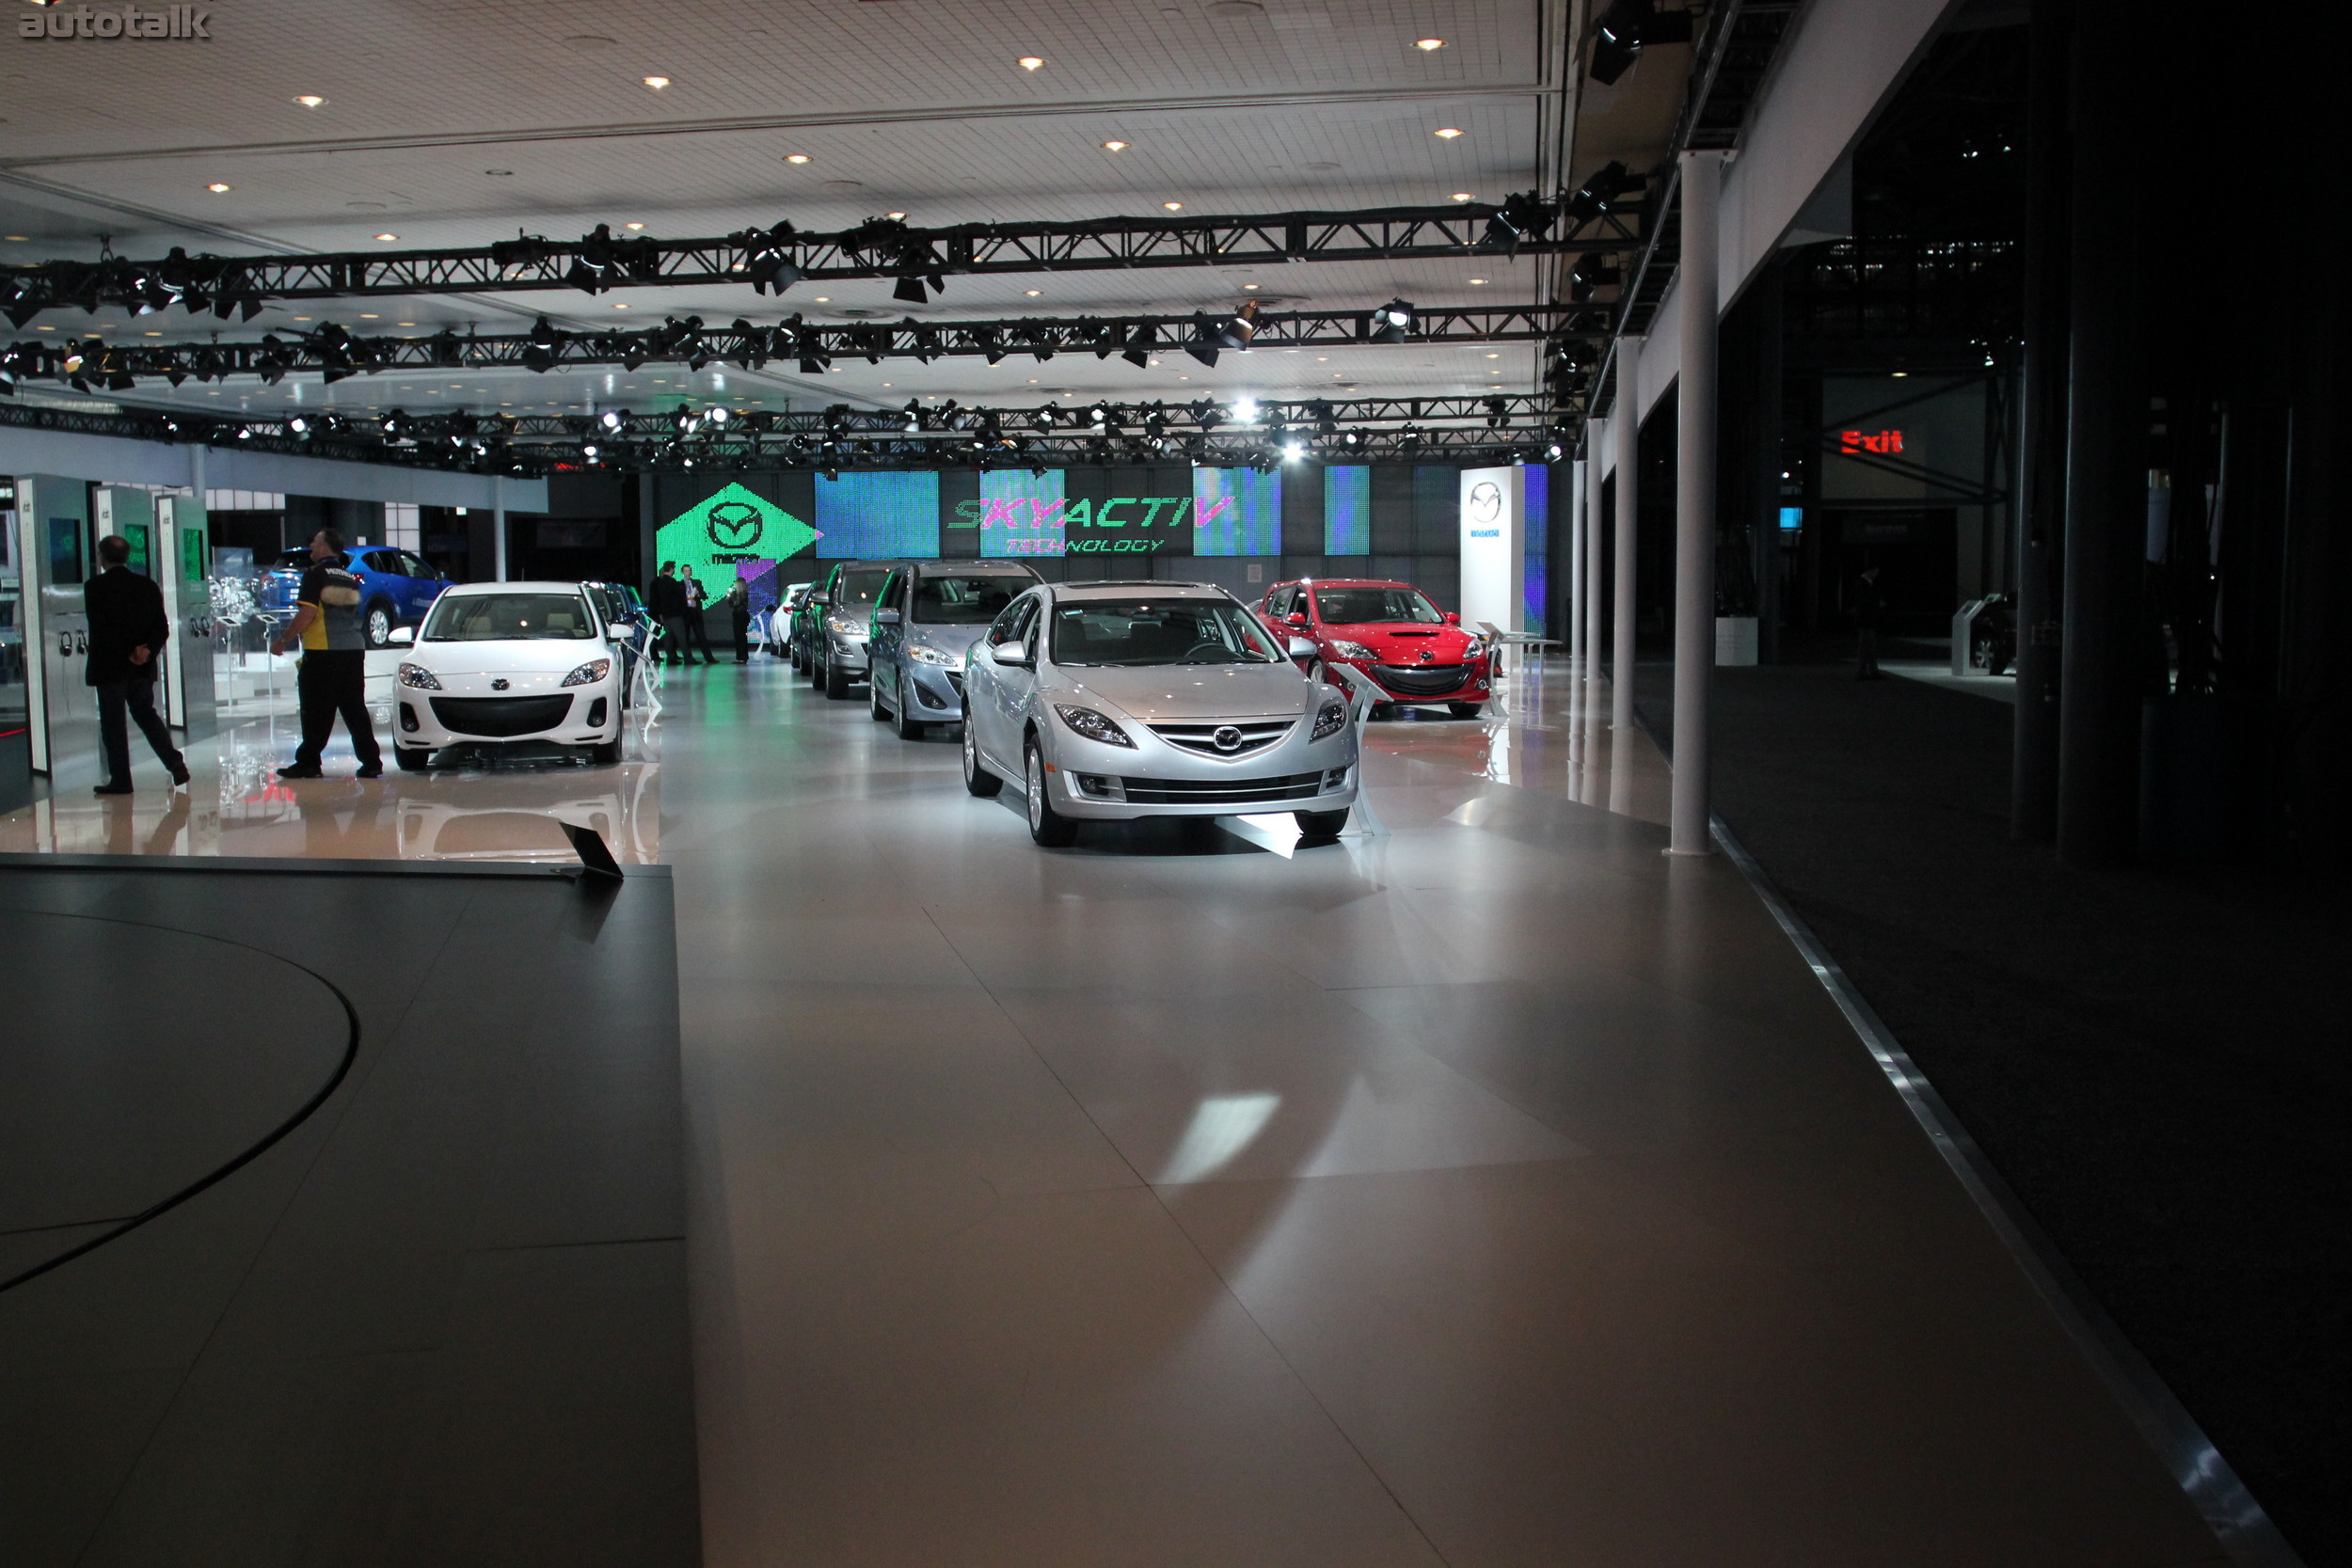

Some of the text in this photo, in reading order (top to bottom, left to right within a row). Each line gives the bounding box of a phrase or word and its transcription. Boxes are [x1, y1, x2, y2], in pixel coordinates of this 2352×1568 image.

[1841, 431, 1903, 453] Exit
[946, 497, 1235, 528] SKYACTIV
[1007, 538, 1166, 553] TECHNOLOGY
